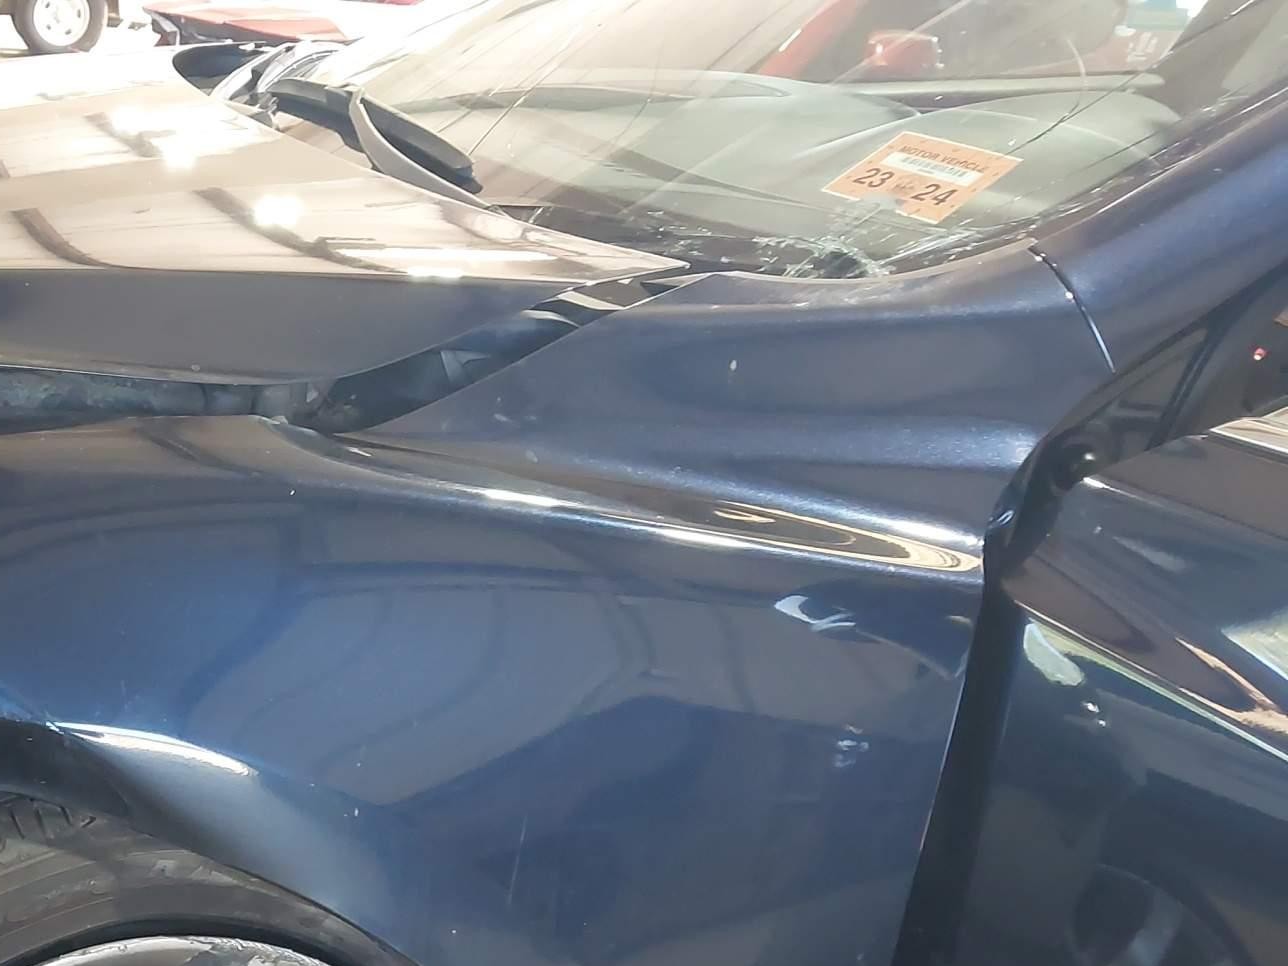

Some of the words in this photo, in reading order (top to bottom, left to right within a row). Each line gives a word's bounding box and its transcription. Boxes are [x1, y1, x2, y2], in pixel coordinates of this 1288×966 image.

[900, 145, 941, 161] MOTOR
[941, 155, 991, 173] VEHICLE
[853, 167, 893, 189] 23
[911, 183, 959, 206] 24
